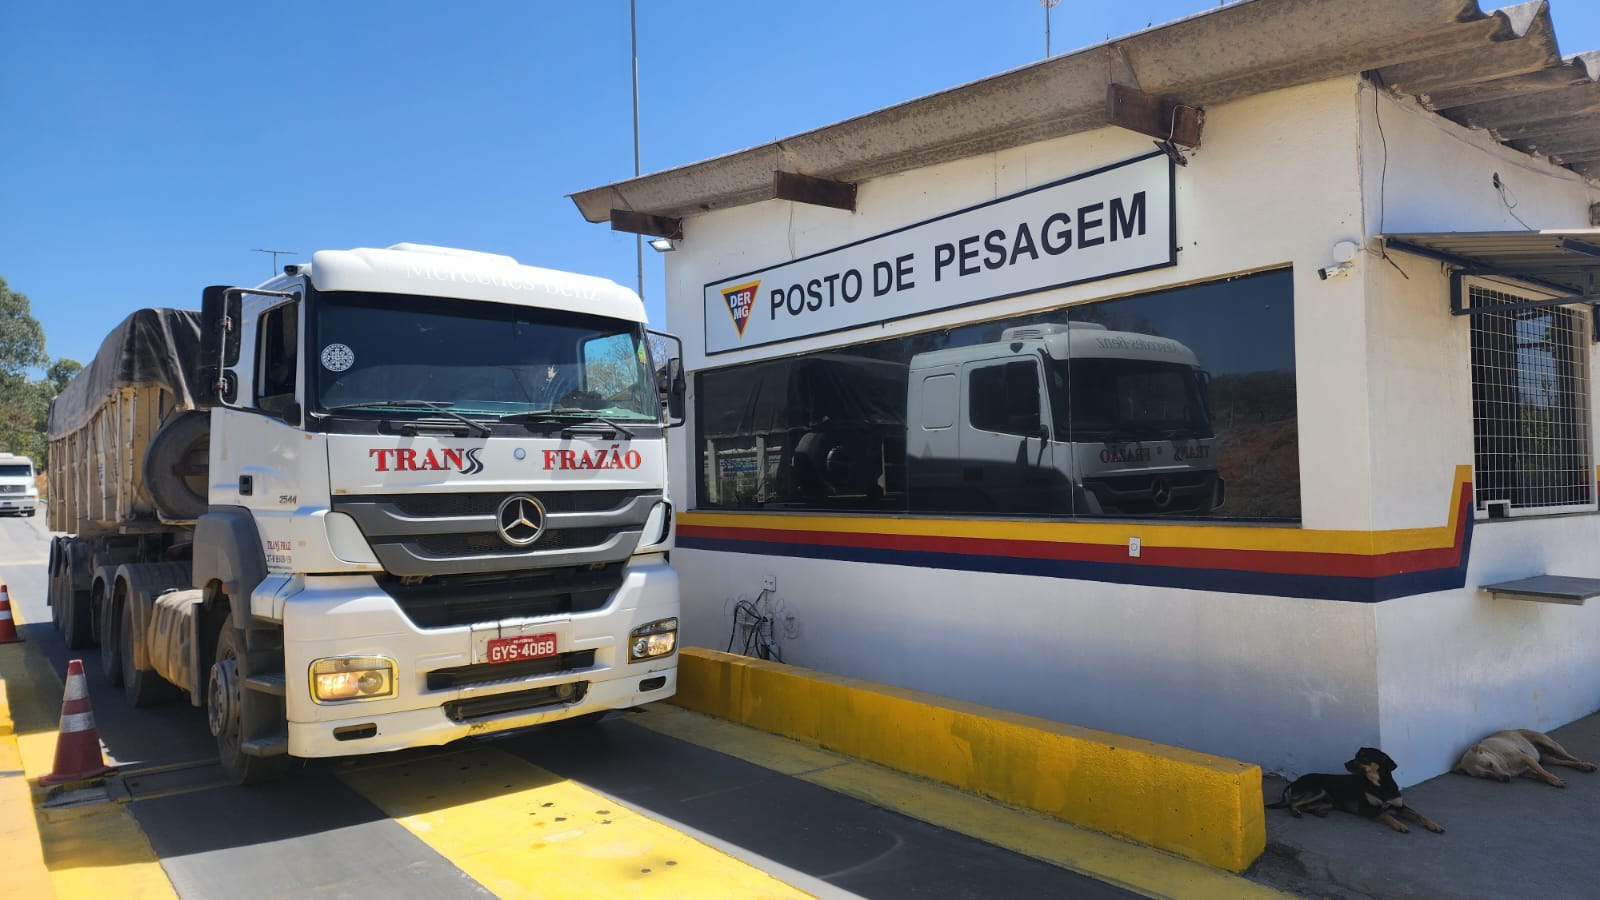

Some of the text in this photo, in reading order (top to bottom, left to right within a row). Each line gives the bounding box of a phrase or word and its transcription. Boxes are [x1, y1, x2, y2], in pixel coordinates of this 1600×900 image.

[770, 190, 1146, 321] POSTO DE PESAGEM
[730, 291, 751, 309] DER
[733, 305, 749, 320] MG
[368, 443, 642, 476] TRANS FRAZÃO
